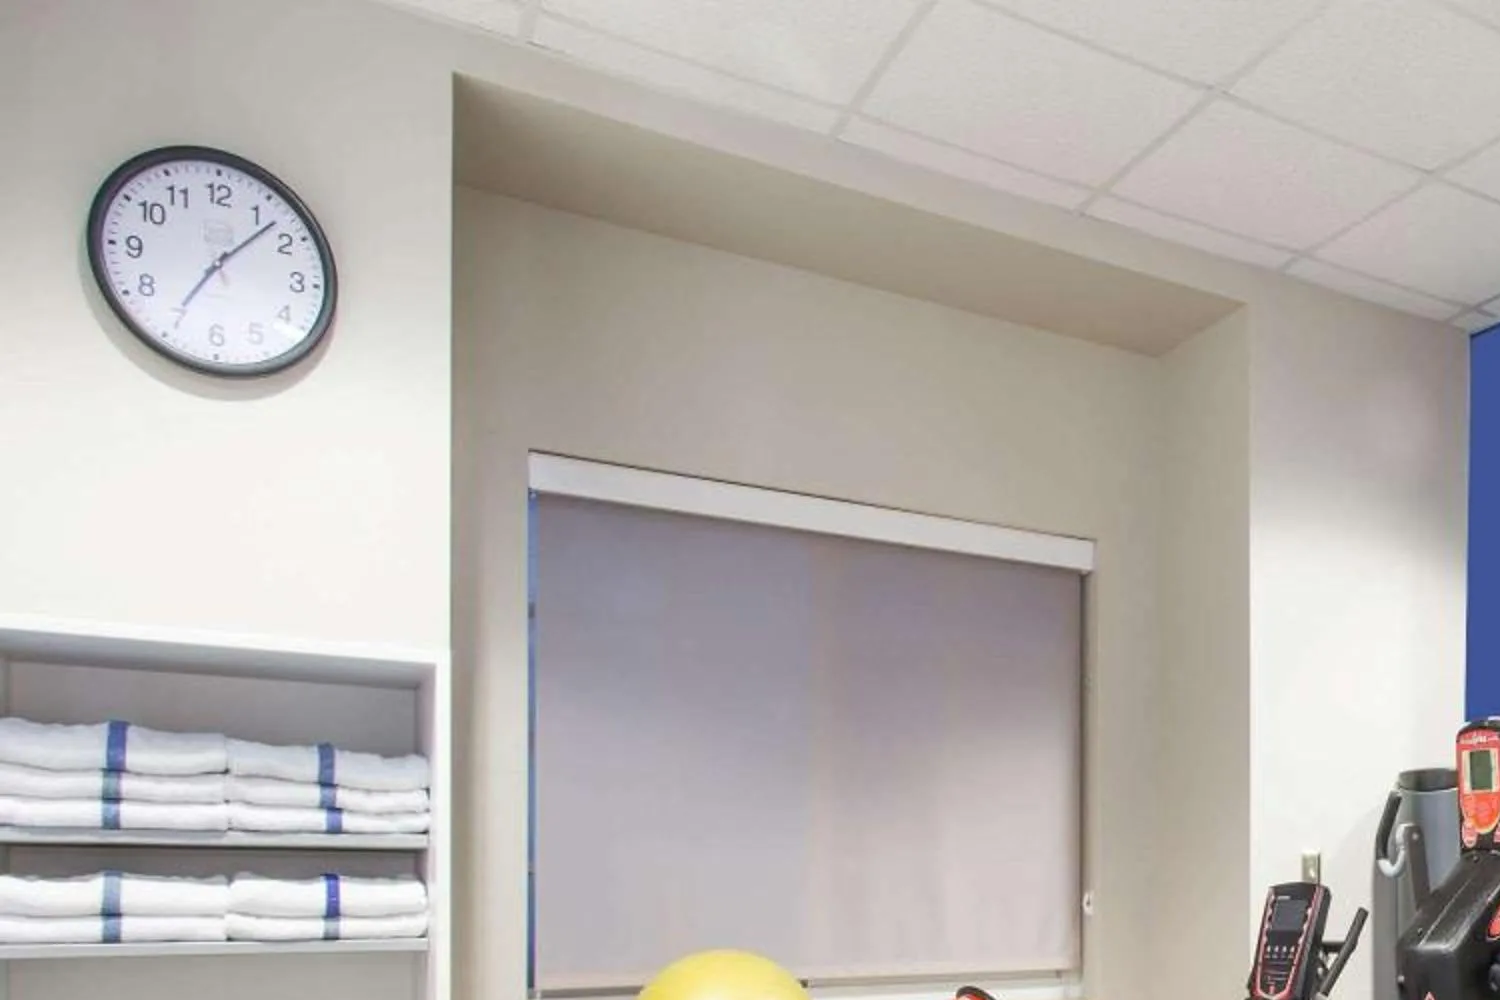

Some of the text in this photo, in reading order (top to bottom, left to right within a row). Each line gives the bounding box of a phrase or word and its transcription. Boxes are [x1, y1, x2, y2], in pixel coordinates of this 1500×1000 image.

[165, 185, 189, 209] 11
[205, 182, 233, 208] 12
[138, 200, 166, 225] 10
[251, 205, 260, 225] 1
[125, 234, 143, 259] 9
[277, 233, 293, 256] 2
[138, 273, 155, 297] 8
[289, 271, 305, 293] 3
[169, 307, 187, 329] 7
[276, 304, 291, 324] 4
[208, 322, 225, 347] 6
[248, 321, 264, 345] 5
